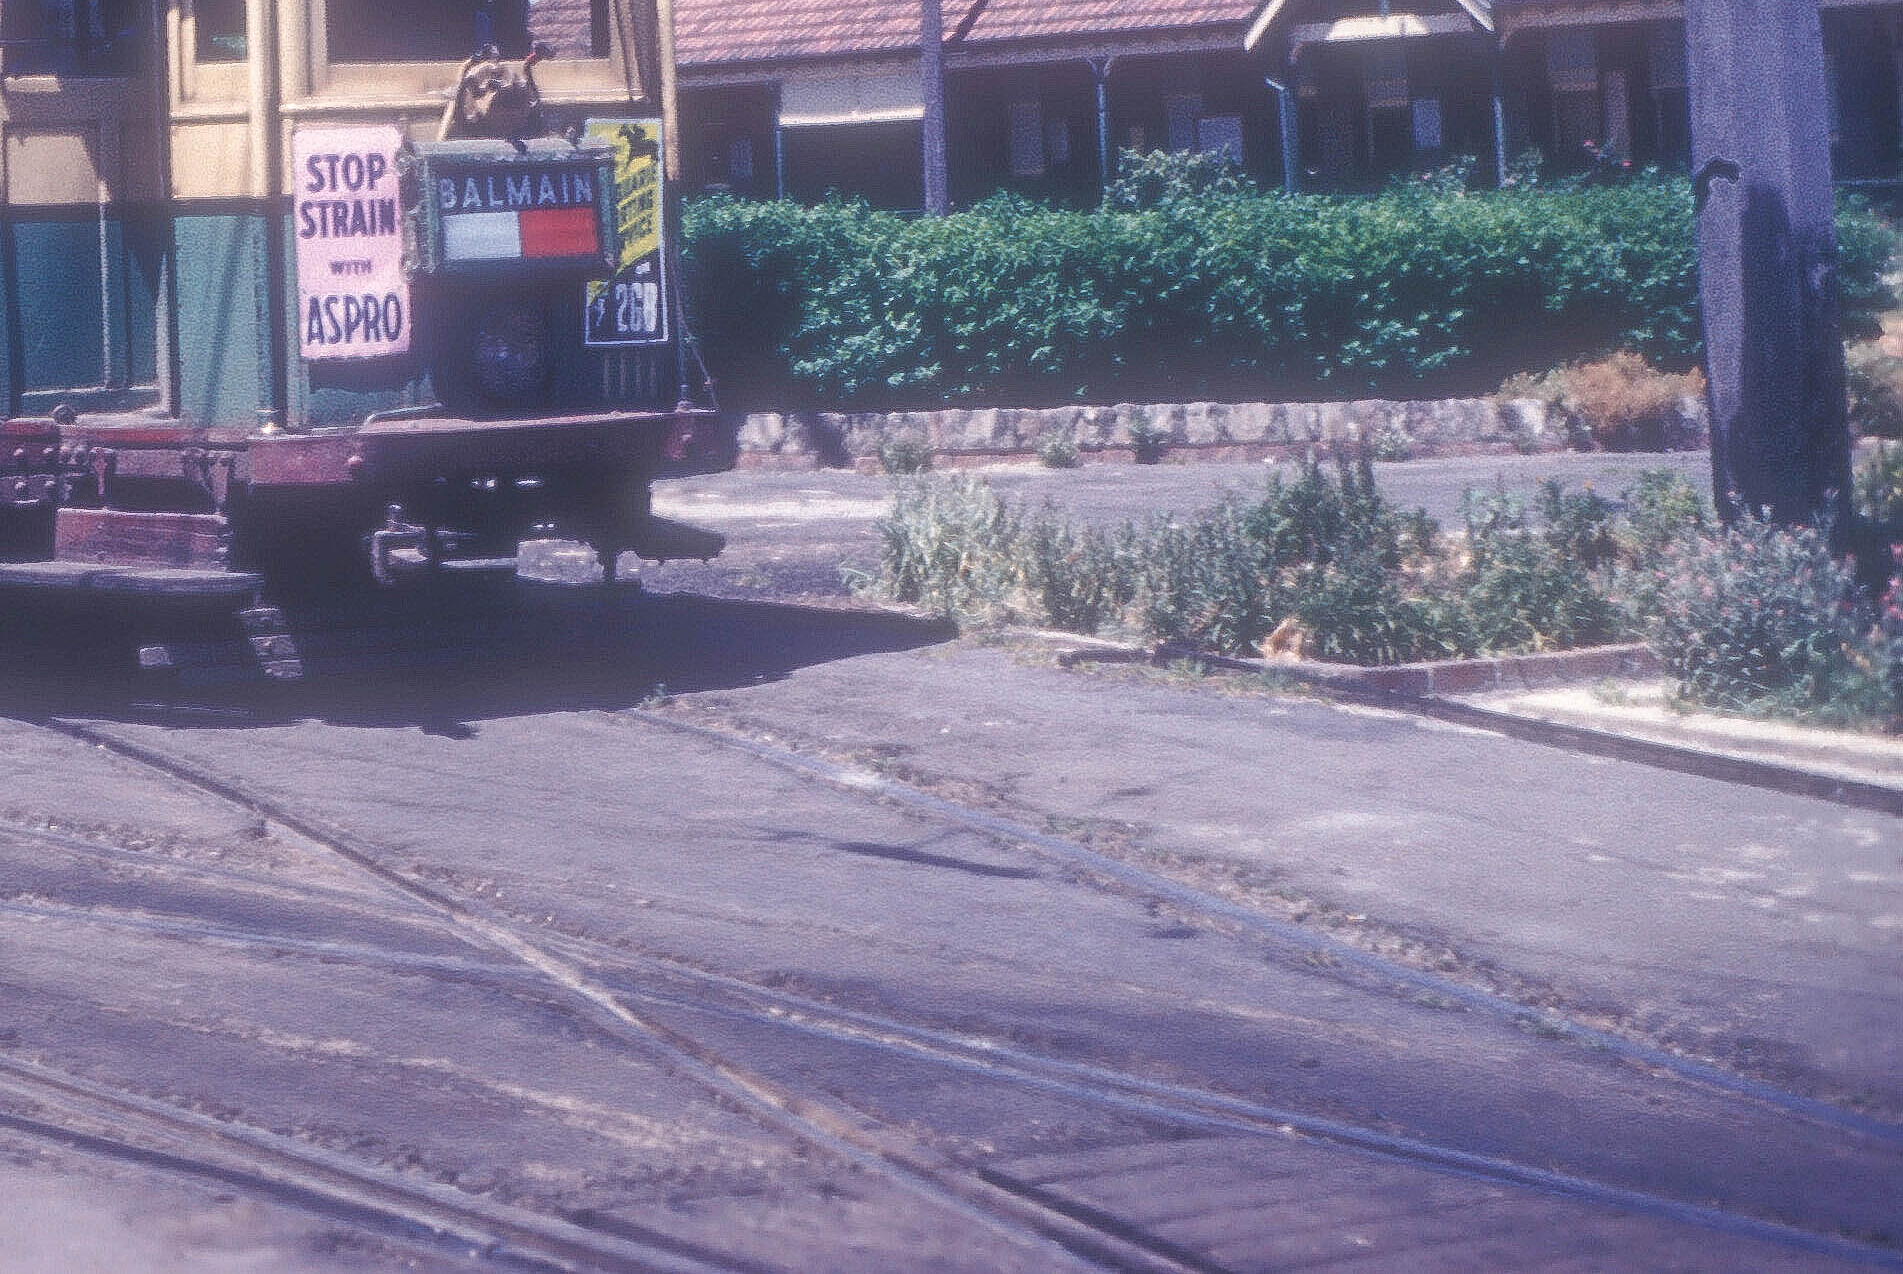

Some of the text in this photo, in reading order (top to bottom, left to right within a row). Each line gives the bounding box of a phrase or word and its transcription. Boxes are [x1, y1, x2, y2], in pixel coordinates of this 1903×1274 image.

[306, 153, 386, 193] STOP
[439, 174, 593, 208] BALMAIN
[300, 198, 395, 239] STRAIN
[329, 260, 372, 275] WITH
[307, 293, 401, 345] ASPRO
